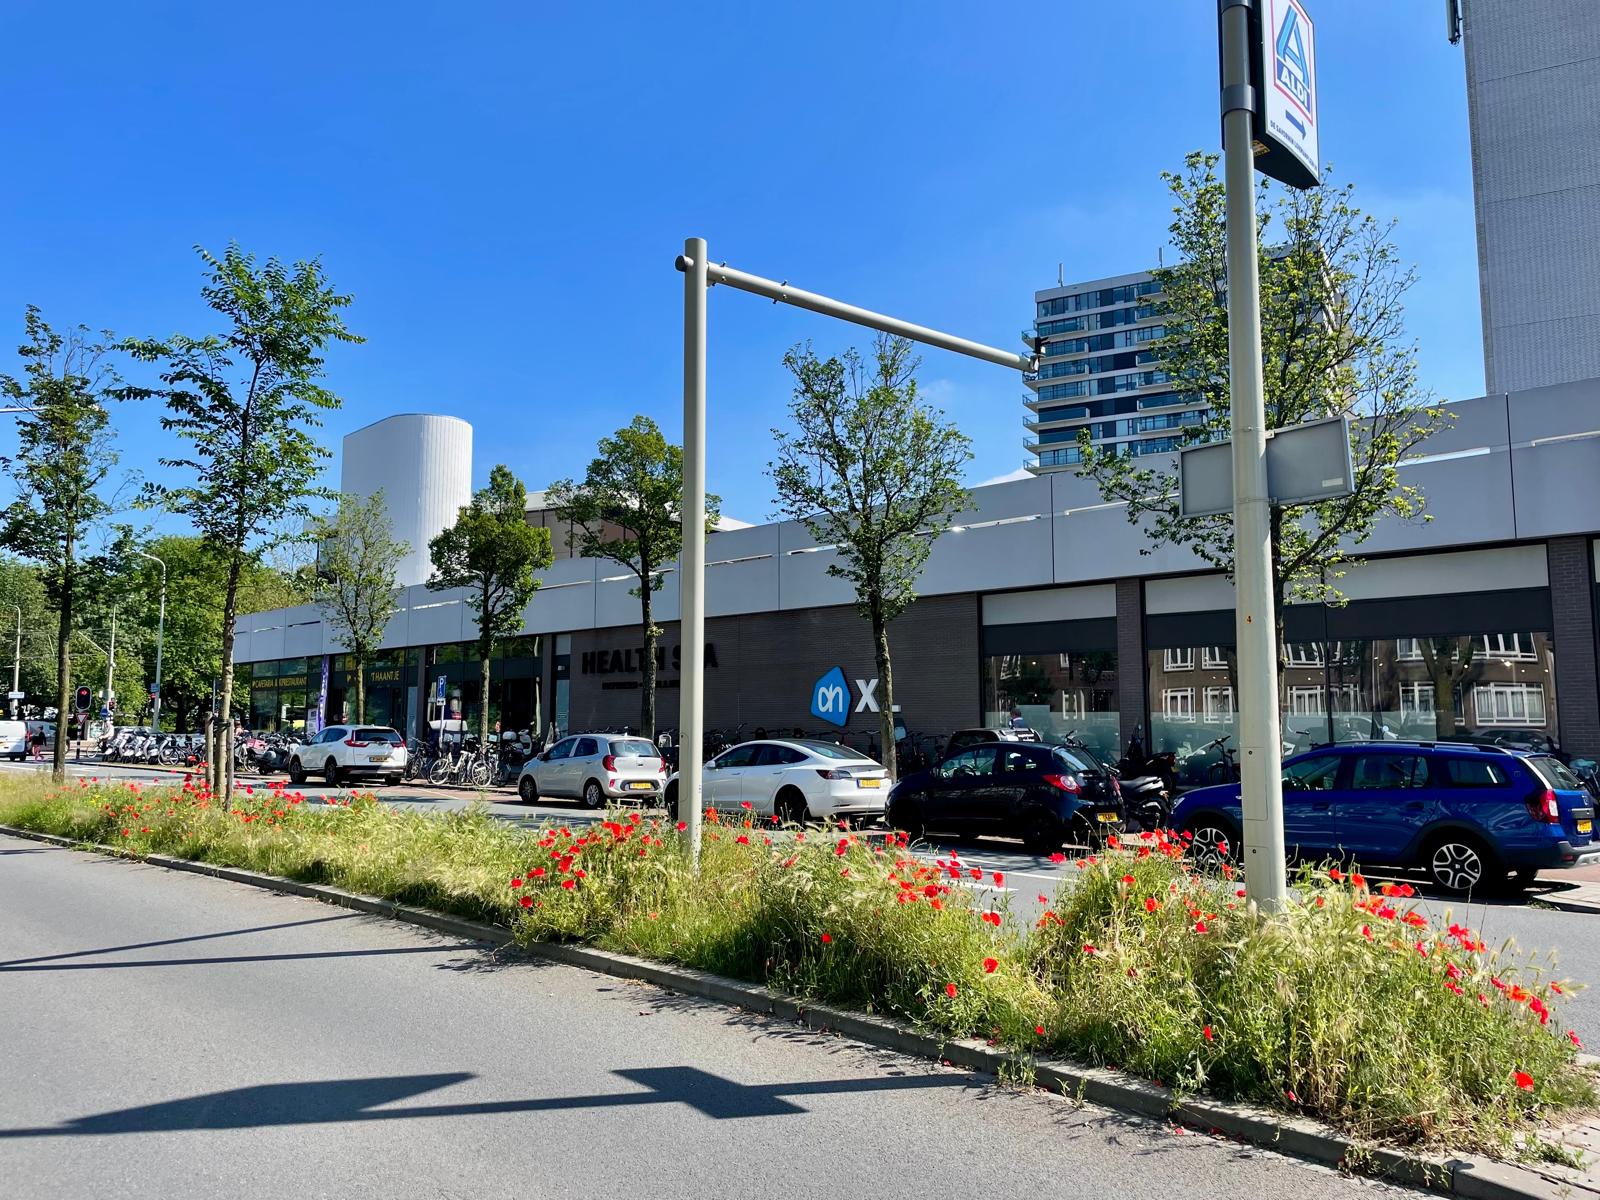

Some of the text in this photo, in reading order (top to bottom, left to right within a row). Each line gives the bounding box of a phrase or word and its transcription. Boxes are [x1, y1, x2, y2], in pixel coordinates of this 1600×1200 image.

[1280, 68, 1309, 107] ALDI
[582, 644, 718, 674] HEALTH SA
[854, 679, 902, 713] X
